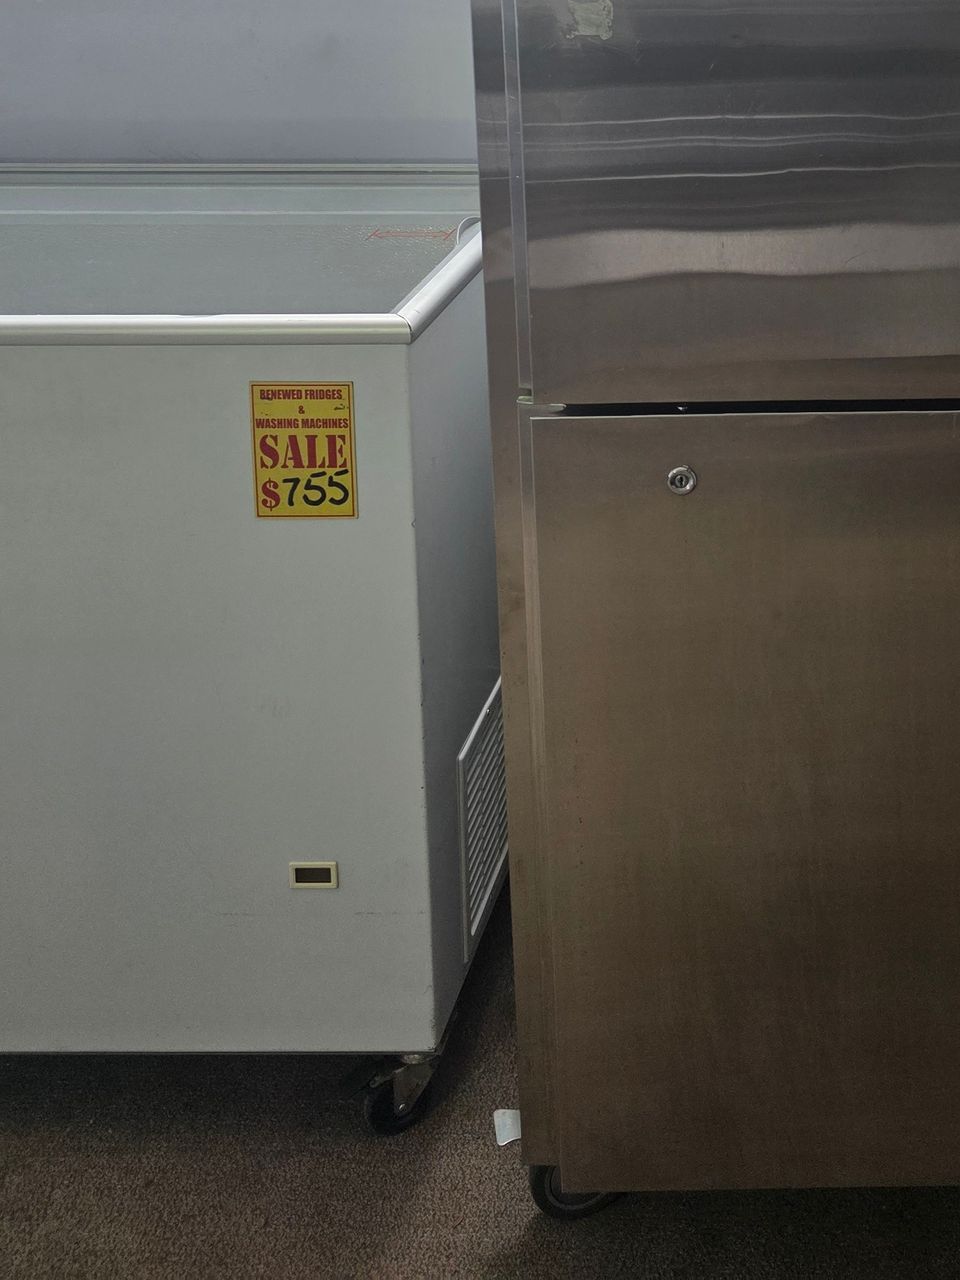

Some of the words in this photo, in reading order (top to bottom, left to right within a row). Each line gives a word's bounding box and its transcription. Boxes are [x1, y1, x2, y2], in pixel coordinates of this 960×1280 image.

[304, 389, 342, 400] FRIDGES
[298, 405, 305, 414] &
[256, 418, 300, 429] WASHING
[301, 418, 349, 429] MACHINES
[259, 434, 348, 469] SALE
